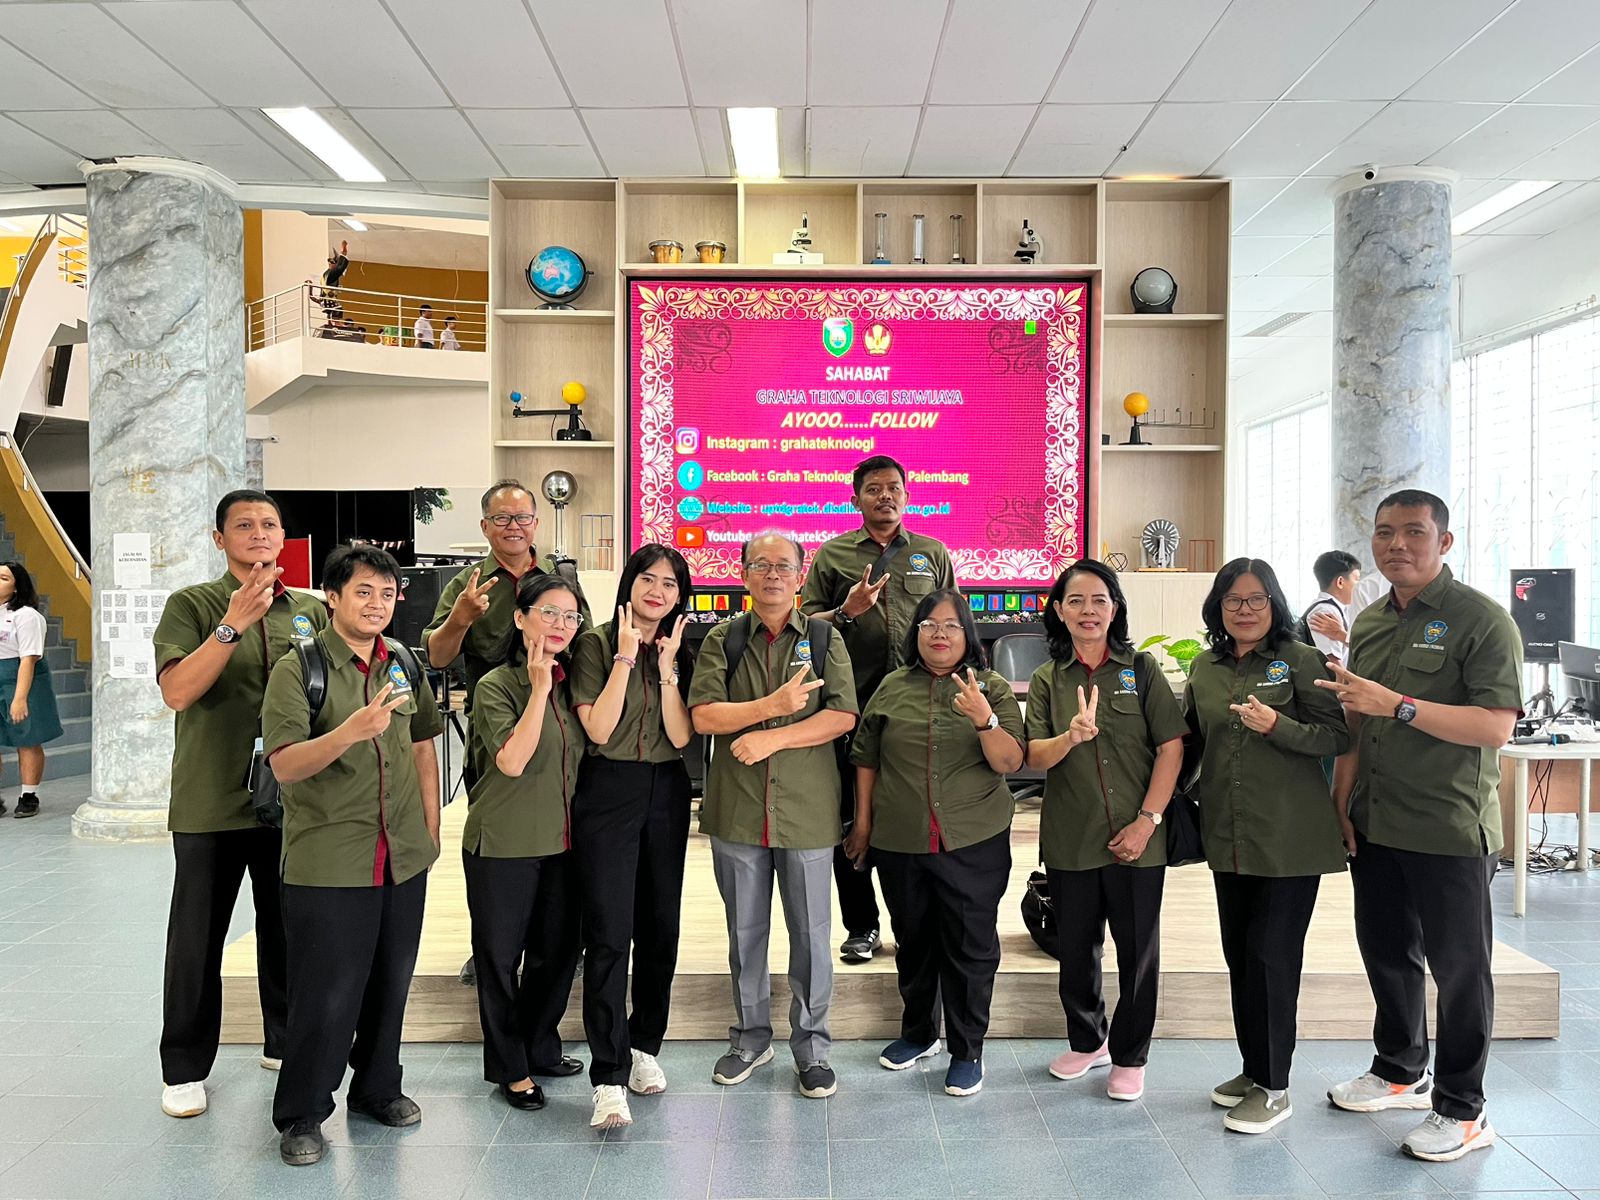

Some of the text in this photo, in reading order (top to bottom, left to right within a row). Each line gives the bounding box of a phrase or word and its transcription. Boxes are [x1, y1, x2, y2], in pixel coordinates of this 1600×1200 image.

[825, 366, 891, 381] SAHABAT
[756, 389, 964, 405] GRAHA TEKNOLOGI SRIWIJAYA
[706, 436, 770, 453] Instagram
[780, 436, 875, 453] grahateknologi
[706, 469, 759, 482] Facebook
[766, 470, 800, 483] Graha
[801, 470, 854, 485] Teknologi
[907, 469, 970, 485] Palembang
[706, 501, 752, 515] Website
[706, 529, 752, 543] Youtube
